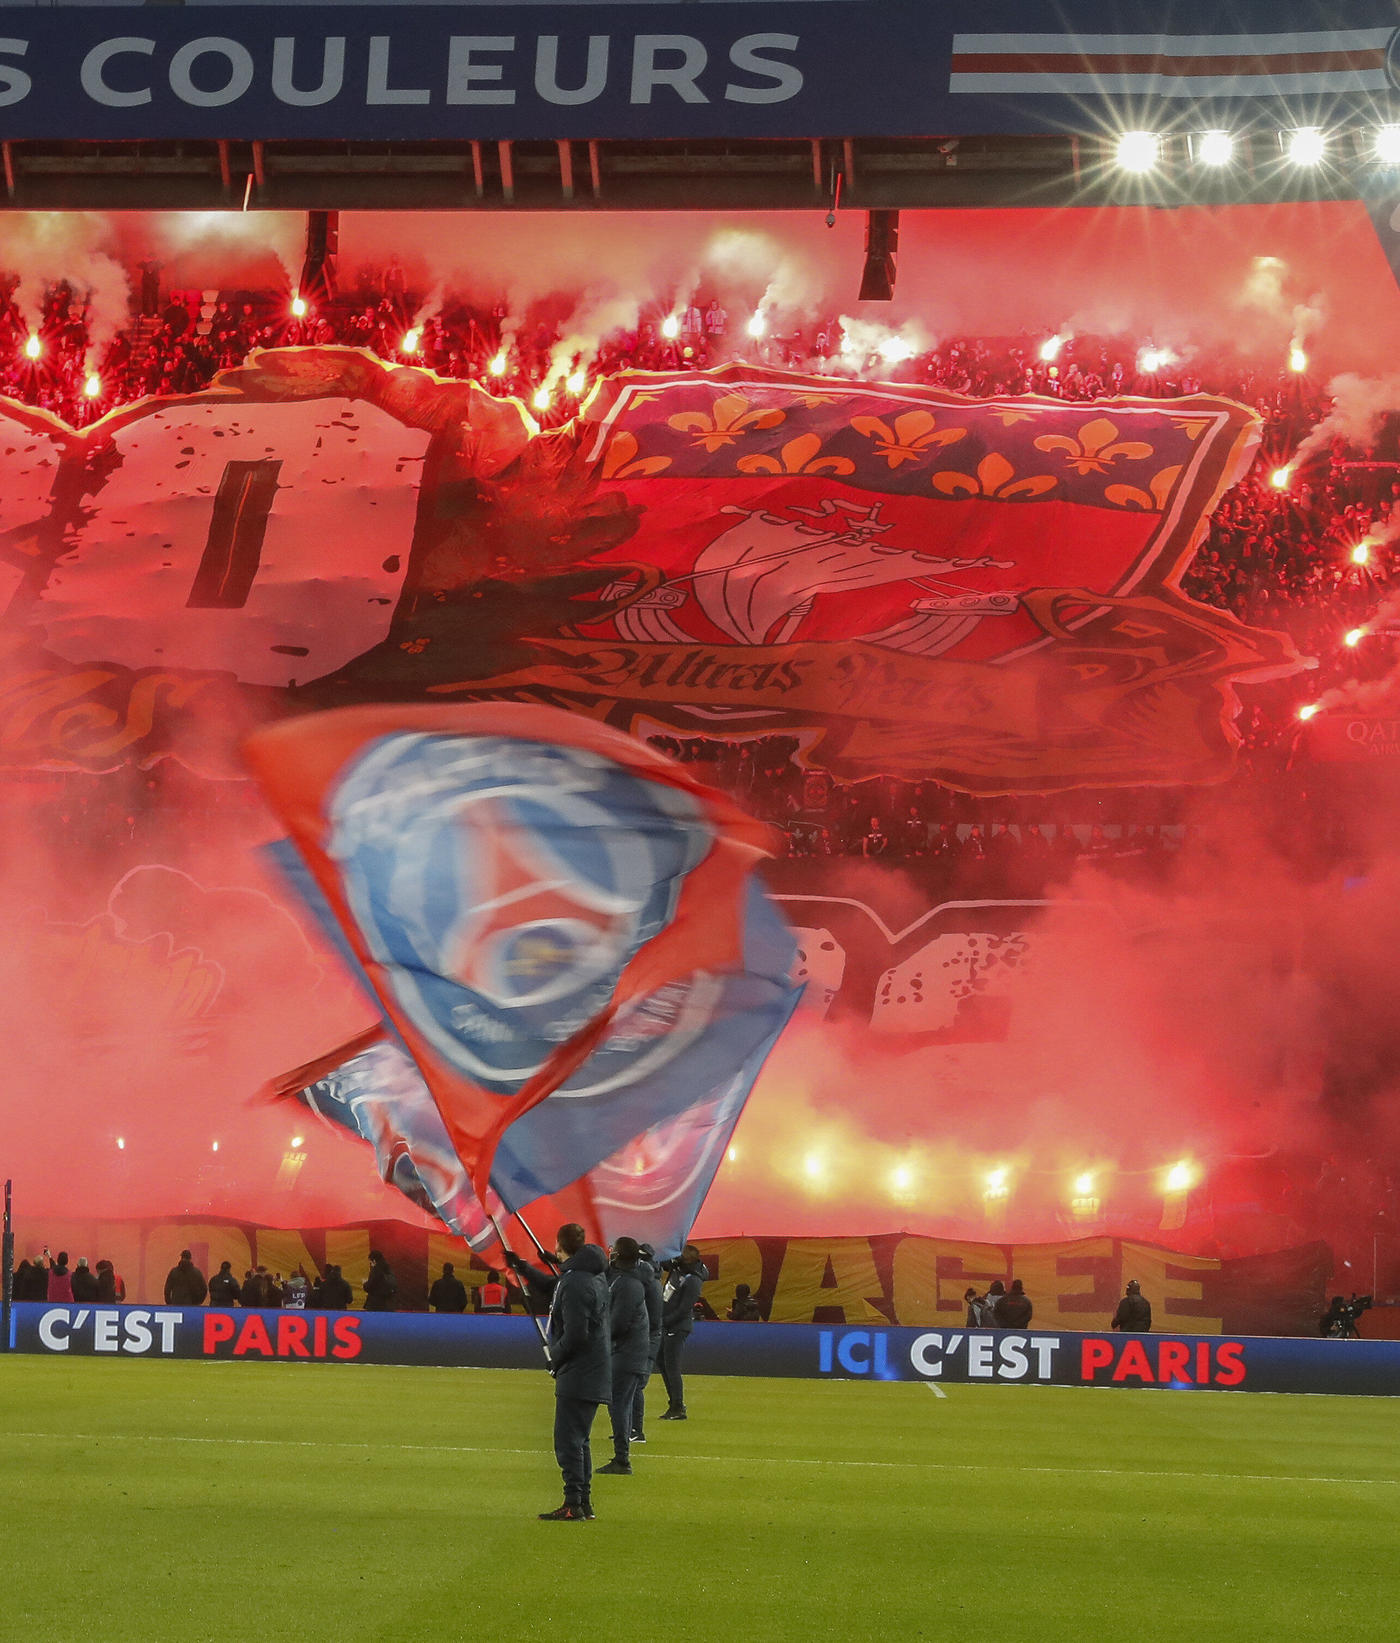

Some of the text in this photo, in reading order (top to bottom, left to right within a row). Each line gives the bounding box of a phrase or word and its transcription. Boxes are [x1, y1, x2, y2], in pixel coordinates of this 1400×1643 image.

[79, 32, 805, 107] COULEURS
[38, 1308, 184, 1354] C'EST
[202, 1313, 363, 1359] PARIS
[818, 1331, 1247, 1386] ICI C'EST PARIS
